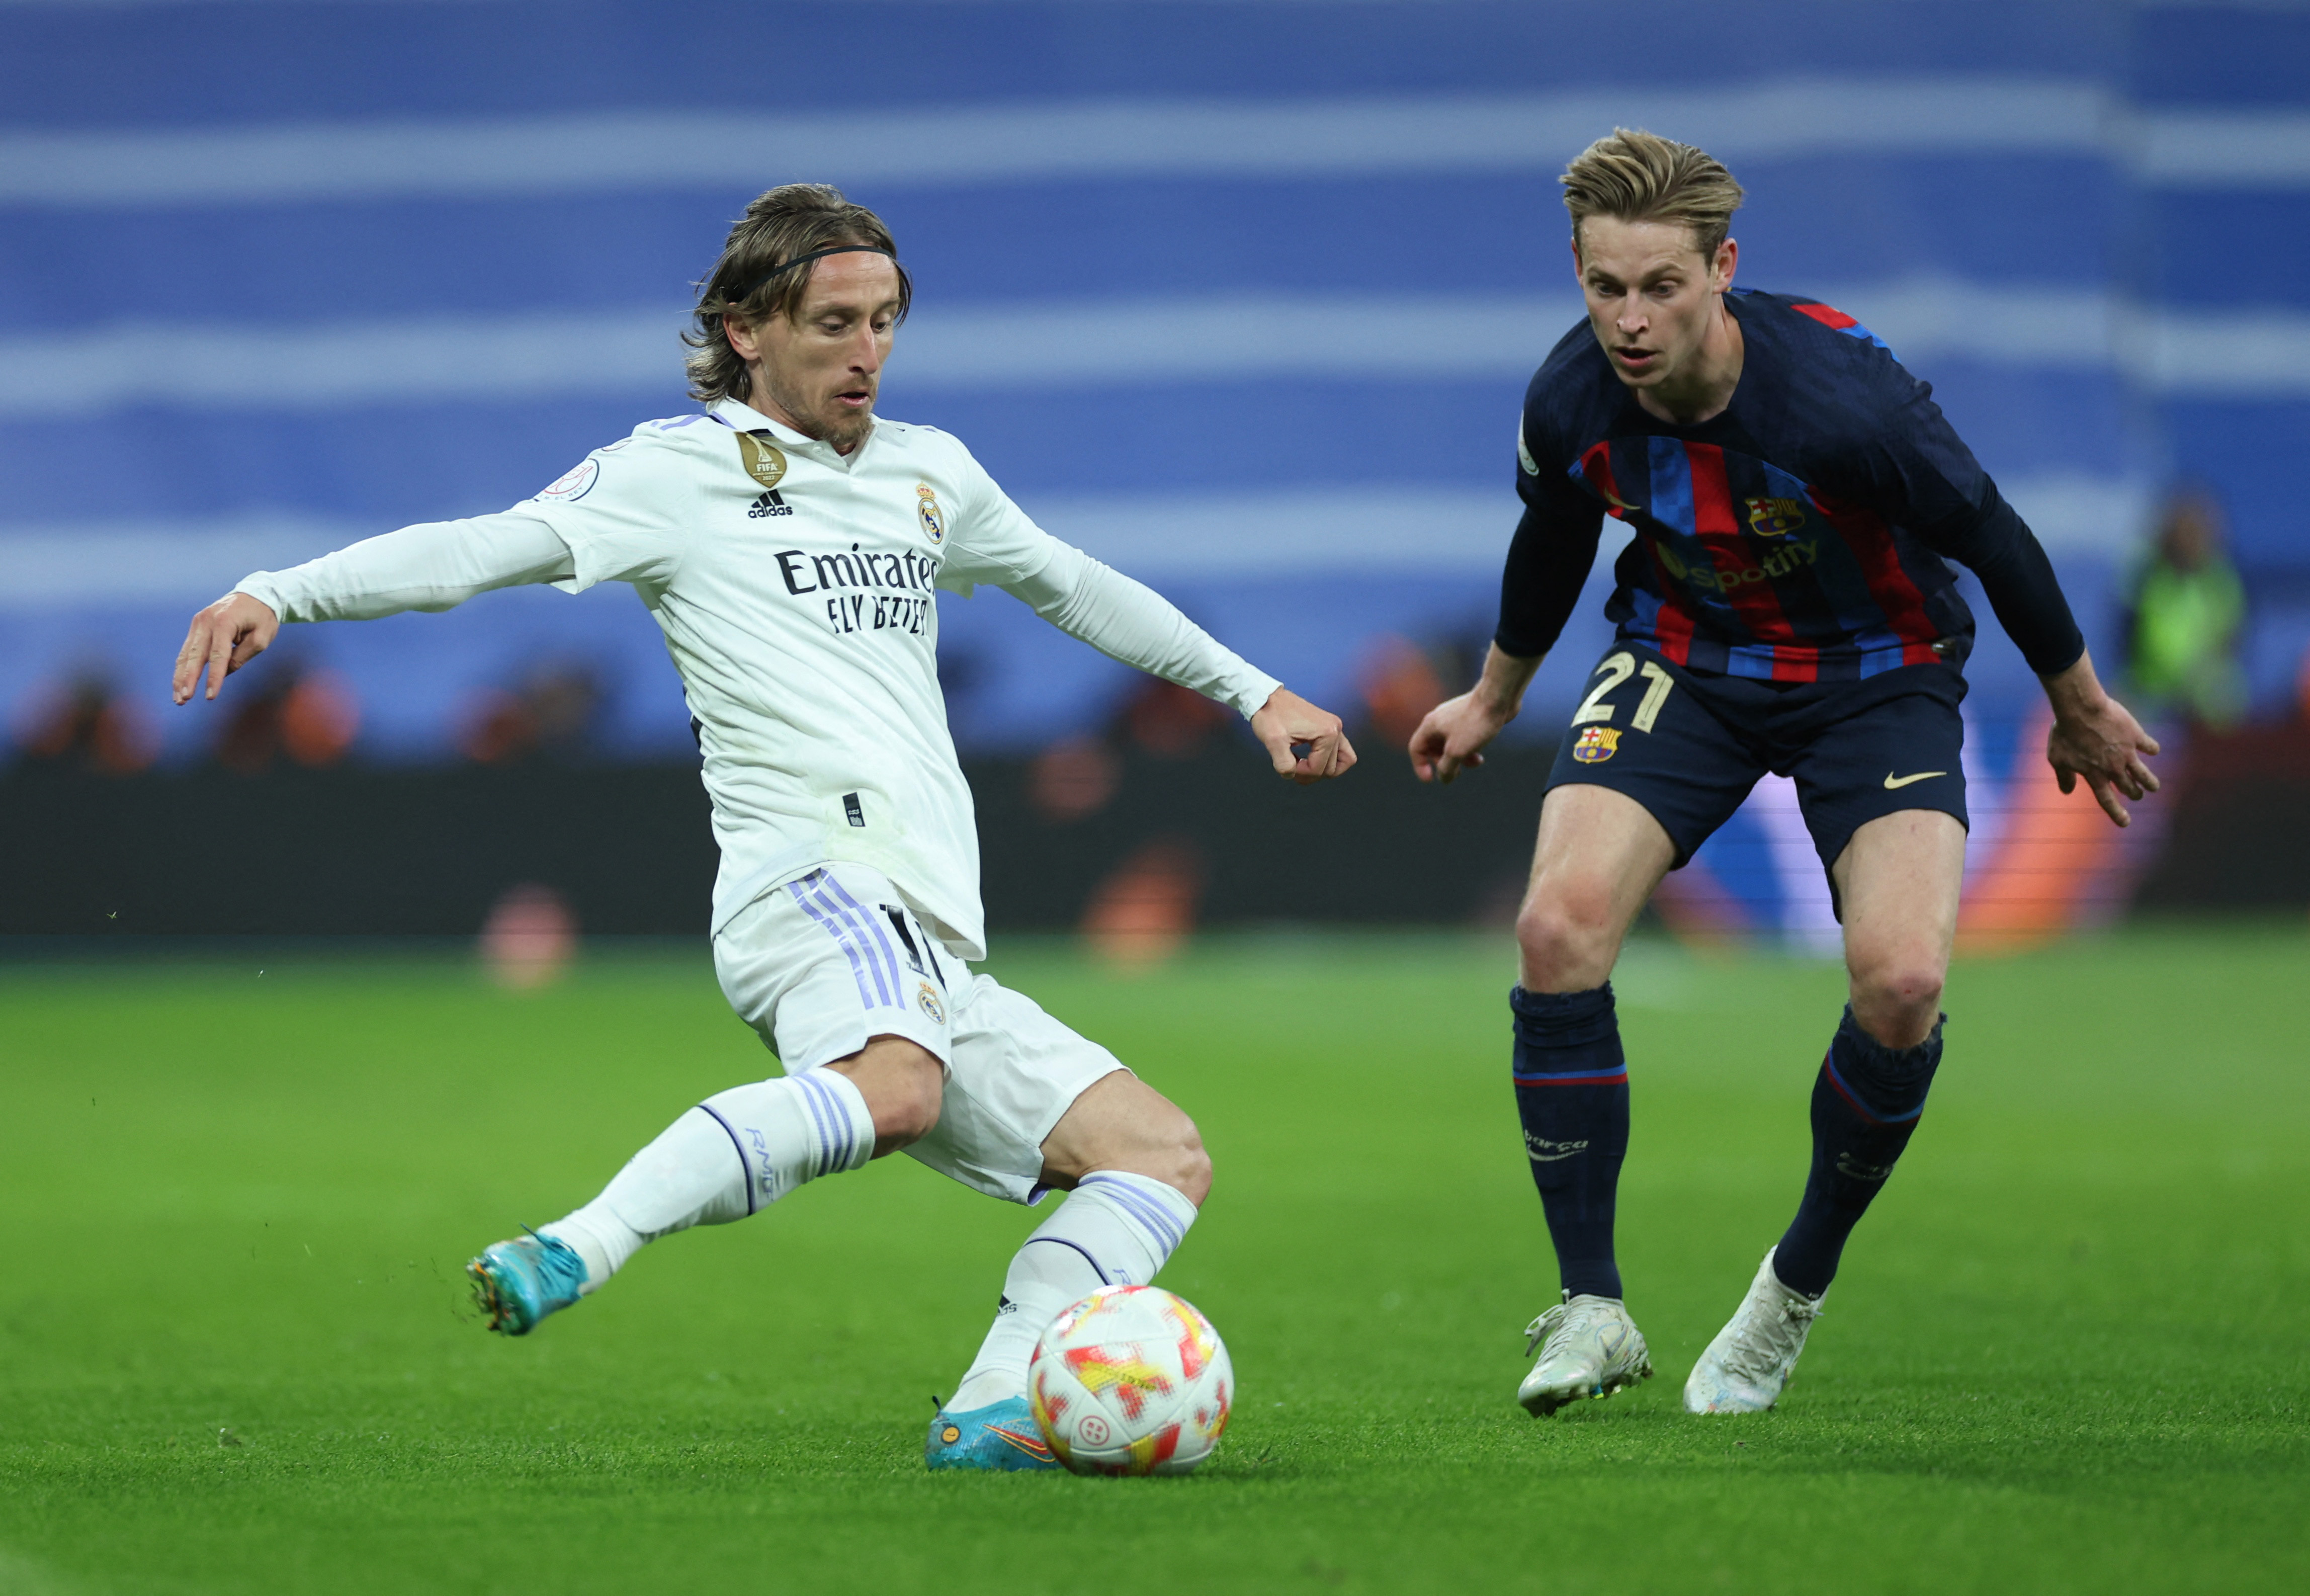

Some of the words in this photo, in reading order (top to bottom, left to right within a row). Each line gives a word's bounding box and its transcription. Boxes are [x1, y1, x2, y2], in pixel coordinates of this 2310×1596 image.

[756, 463, 778, 472] FIFA
[748, 505, 793, 519] adidas
[827, 594, 864, 634] FLY
[1571, 651, 1675, 734] 21
